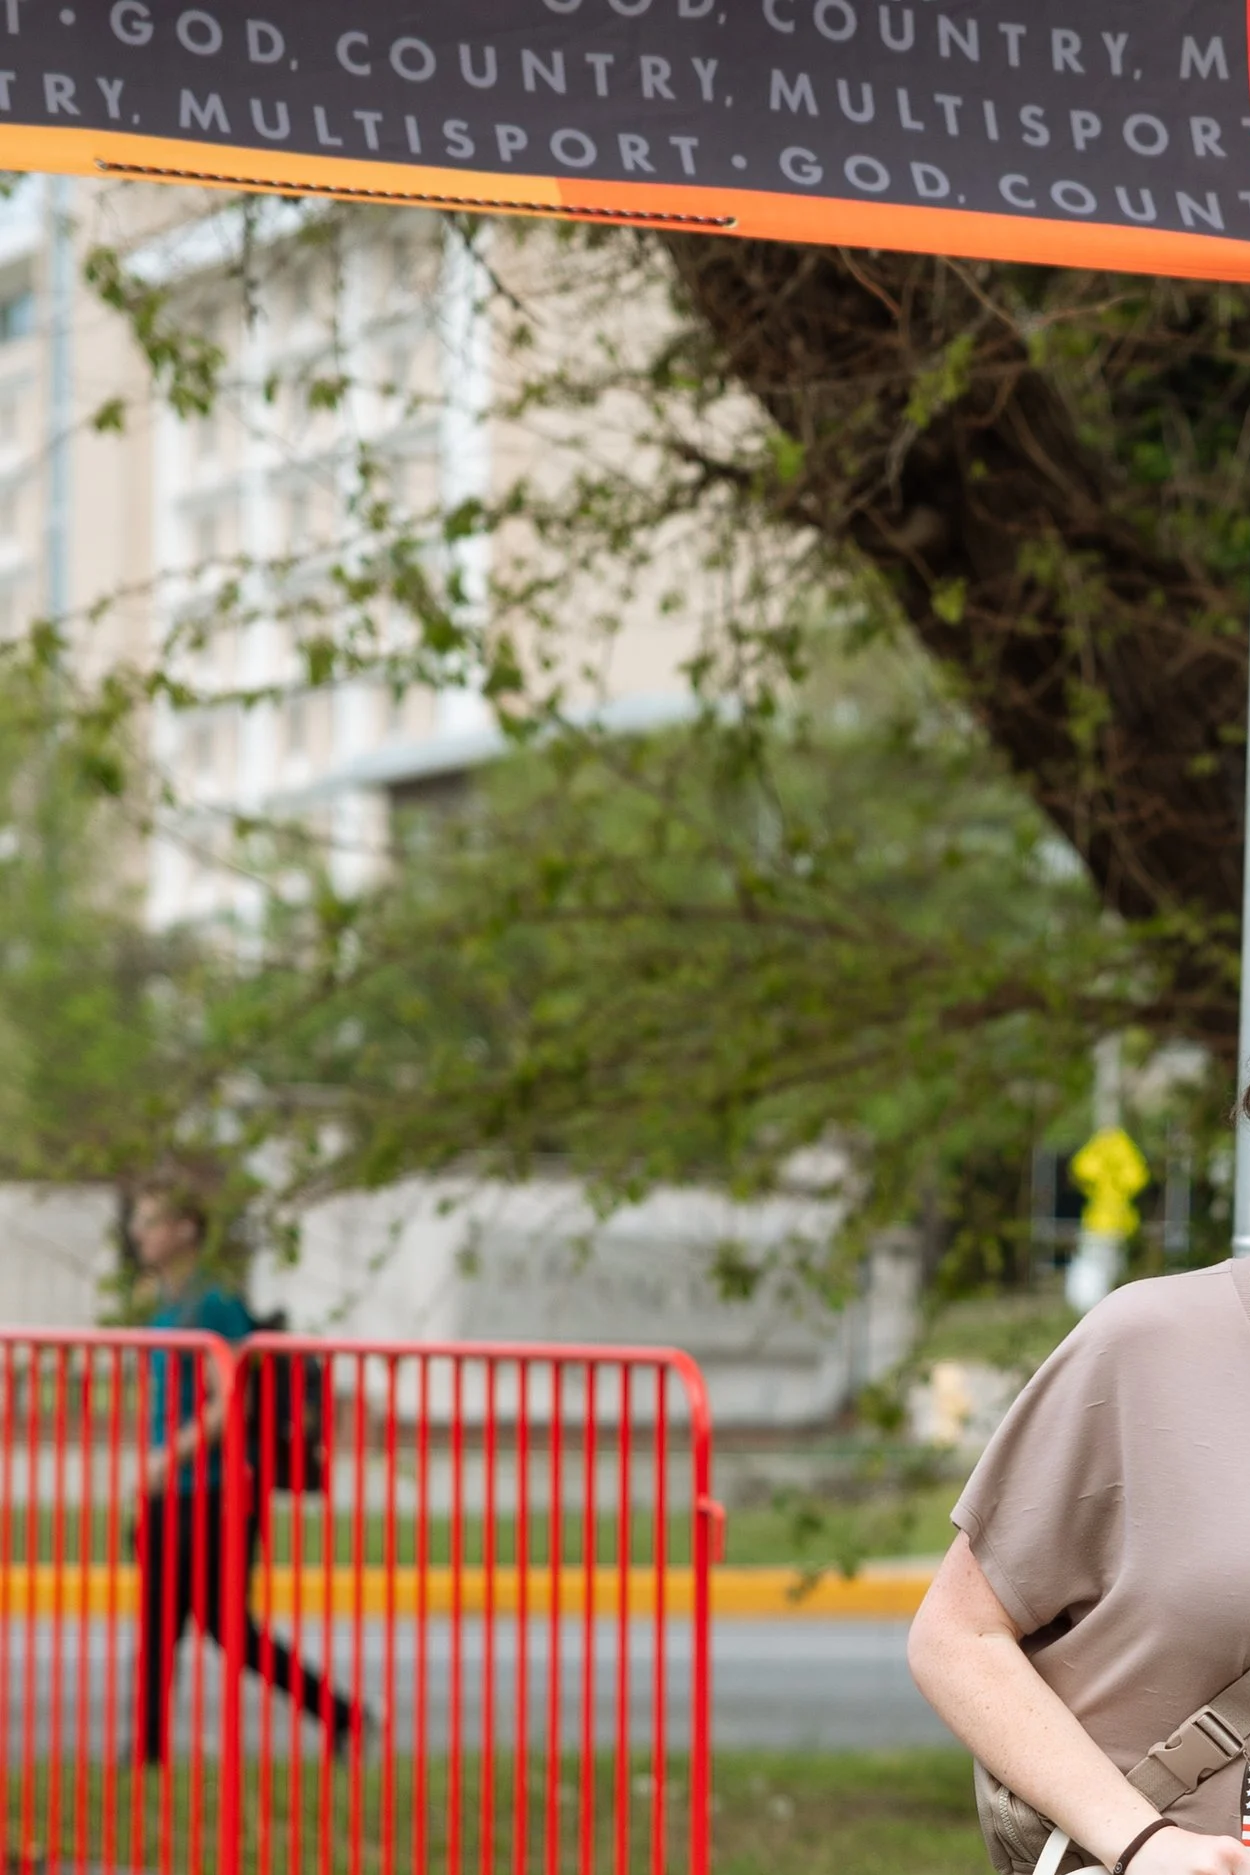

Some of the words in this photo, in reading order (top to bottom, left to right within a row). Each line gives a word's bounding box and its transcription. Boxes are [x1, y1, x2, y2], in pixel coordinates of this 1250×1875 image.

[110, 0, 298, 71] GOD,
[336, 31, 733, 107] COUNTRY,
[179, 89, 699, 177] MULTISPORT
[778, 146, 967, 205] GOD,
